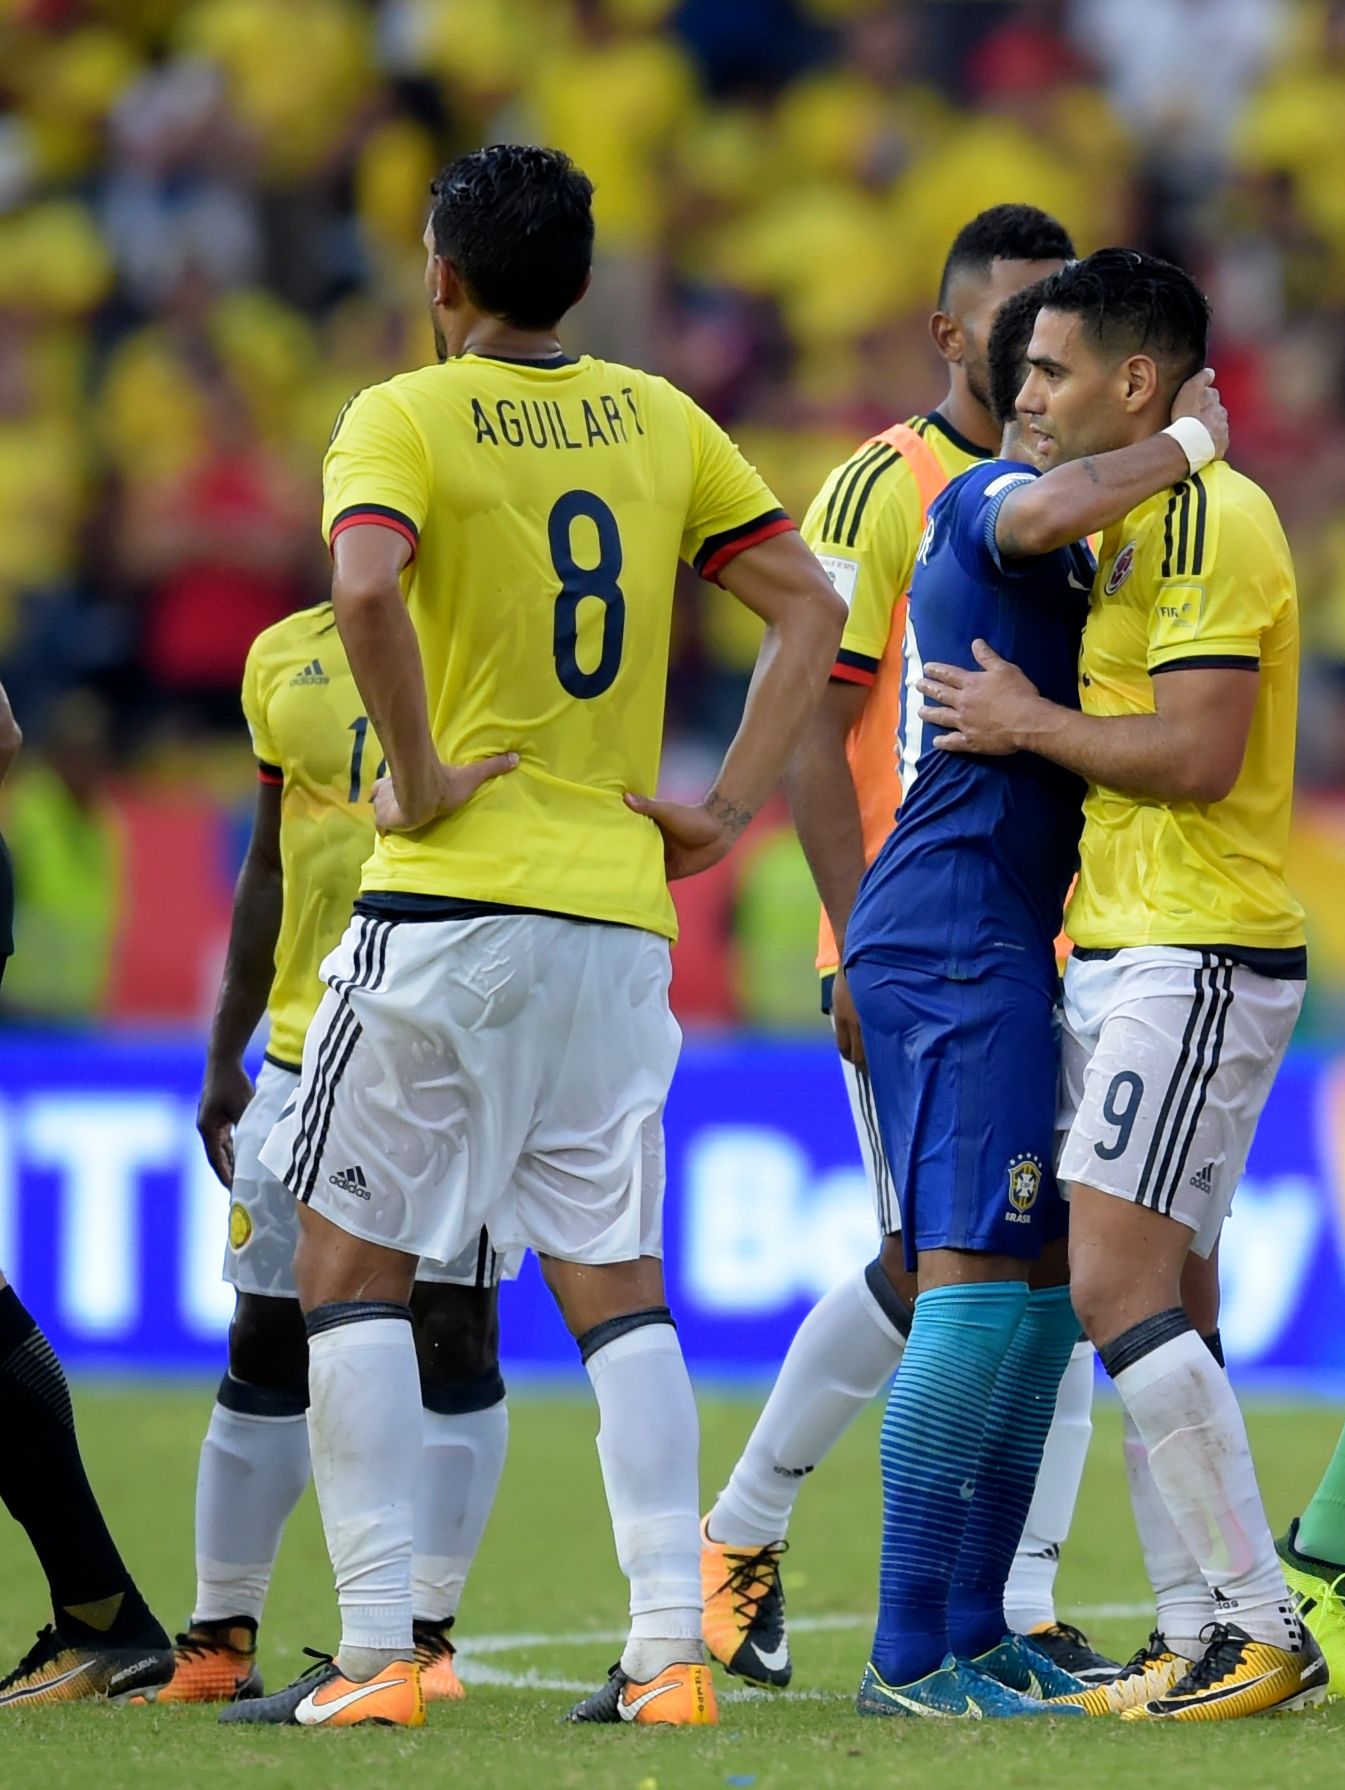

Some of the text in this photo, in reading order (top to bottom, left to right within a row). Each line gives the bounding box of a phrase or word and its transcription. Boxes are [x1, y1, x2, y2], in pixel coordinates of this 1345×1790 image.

[548, 489, 625, 699] 8
[1094, 1070, 1145, 1161] 9
[329, 1175, 372, 1201] adidas
[1005, 1211, 1031, 1224] BRASIL
